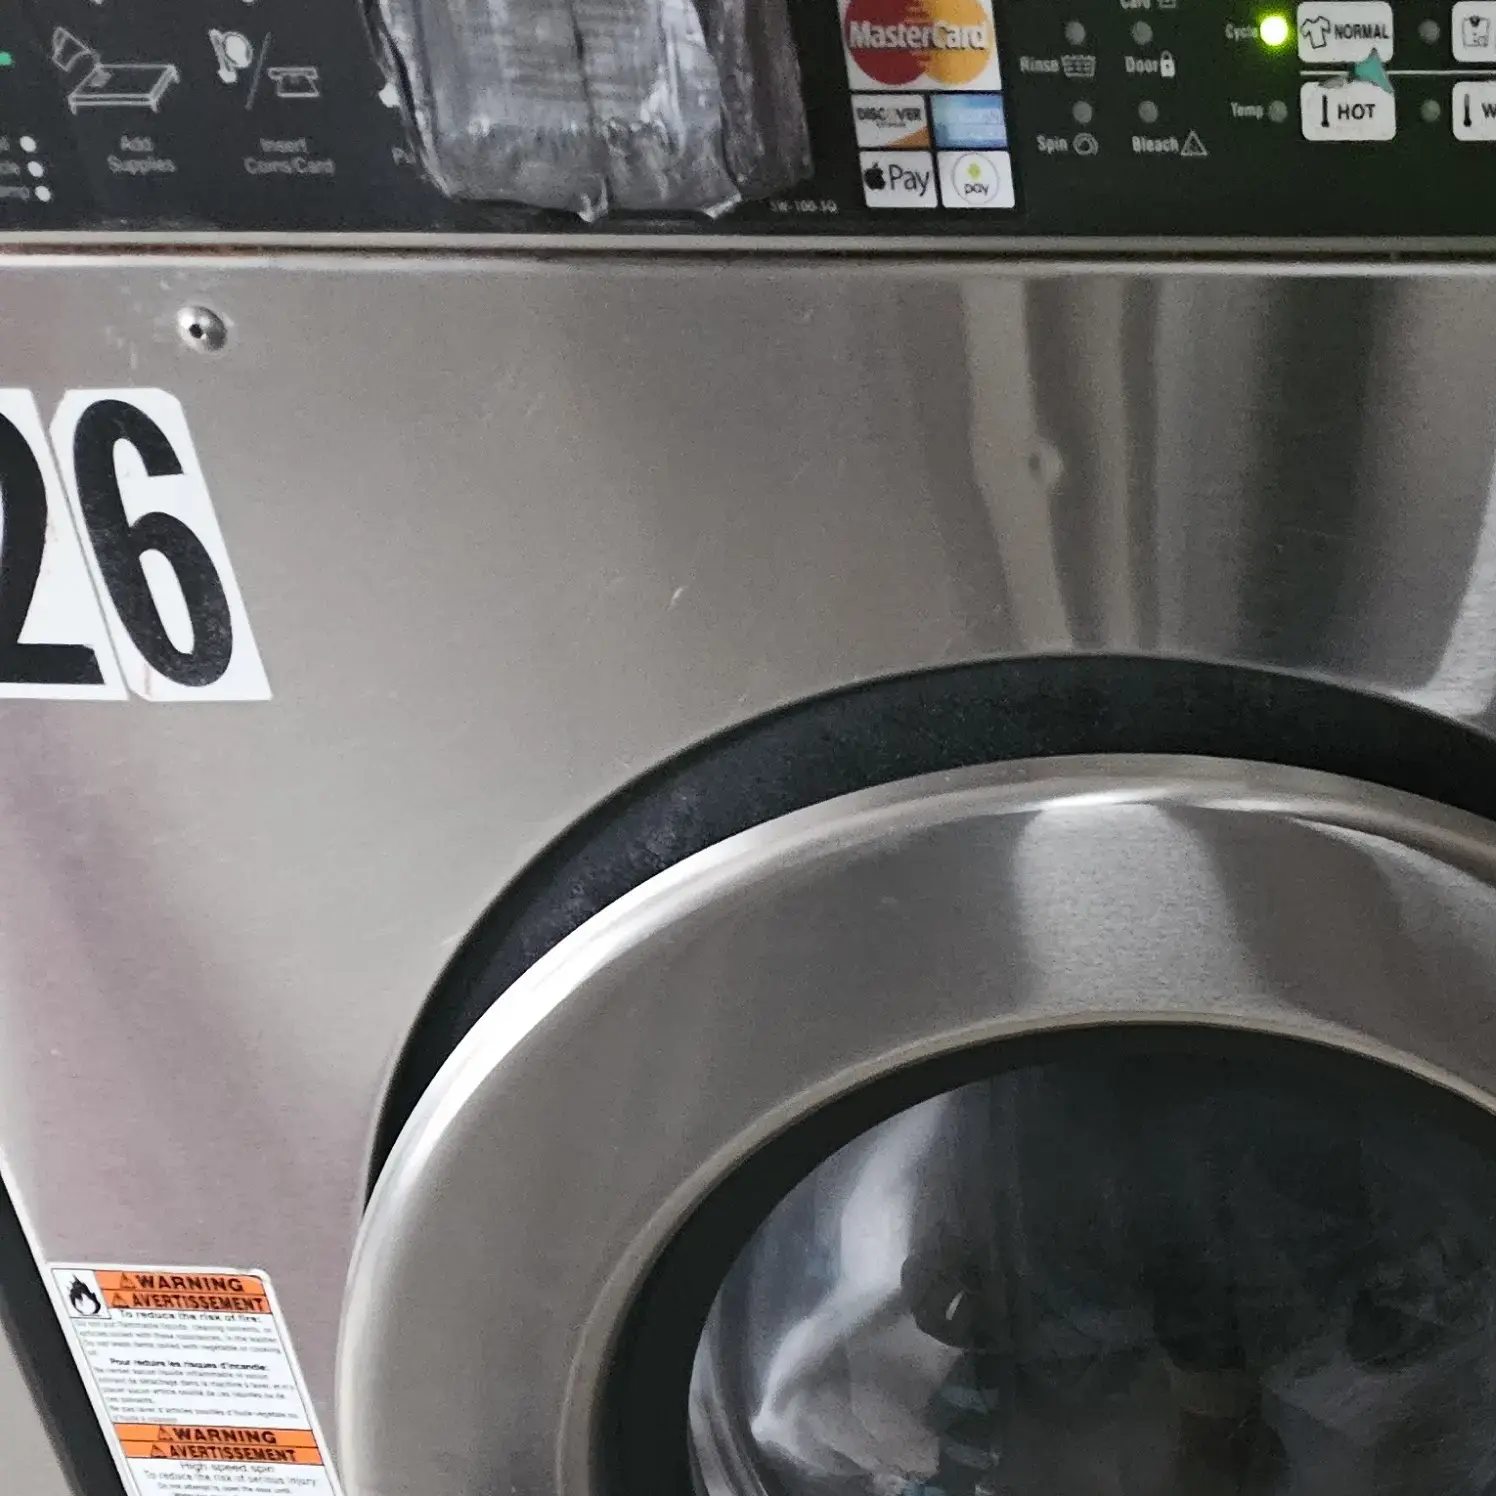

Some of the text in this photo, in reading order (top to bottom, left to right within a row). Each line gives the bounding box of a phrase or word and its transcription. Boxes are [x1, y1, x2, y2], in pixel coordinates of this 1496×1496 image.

[850, 20, 988, 50] MasterCard
[1334, 24, 1390, 40] NORMAL
[1019, 55, 1060, 73] Rinse
[1124, 55, 1159, 73] Door
[1230, 102, 1265, 121] Temp
[1337, 103, 1376, 121] HOT
[1036, 134, 1069, 154] Spin
[1131, 135, 1180, 153] Bleach
[888, 163, 930, 197] Pay
[964, 183, 989, 196] pay
[135, 1274, 244, 1292] WARNING
[132, 1292, 264, 1311] AVERTISSEMENT
[172, 1428, 277, 1444] WARNING
[170, 1444, 296, 1462] AVERTISSEMENT
